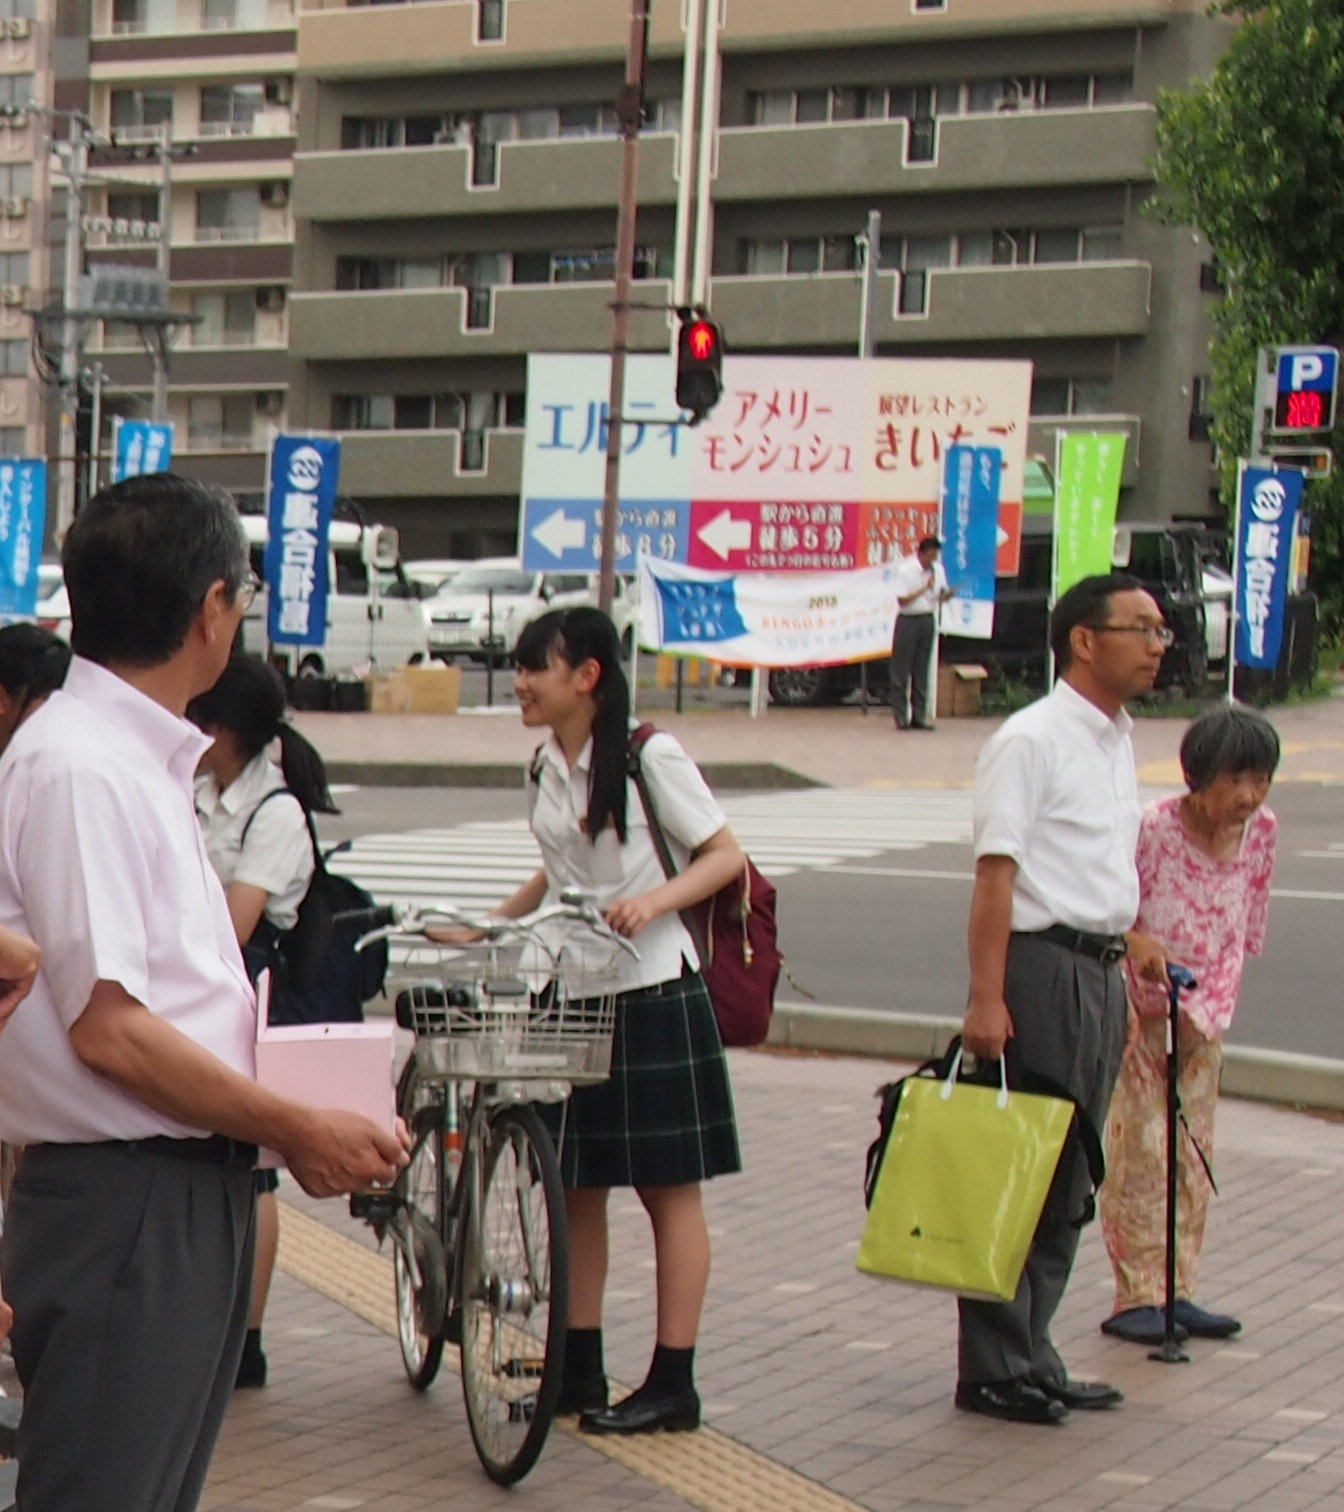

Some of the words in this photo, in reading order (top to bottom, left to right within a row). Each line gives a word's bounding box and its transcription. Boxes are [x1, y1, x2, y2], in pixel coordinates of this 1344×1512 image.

[1291, 355, 1323, 391] P
[735, 389, 833, 430] アメリー
[879, 393, 989, 417] 展望レストラン
[702, 434, 854, 472] モンシュシュ
[758, 524, 846, 552] 徒歩5分
